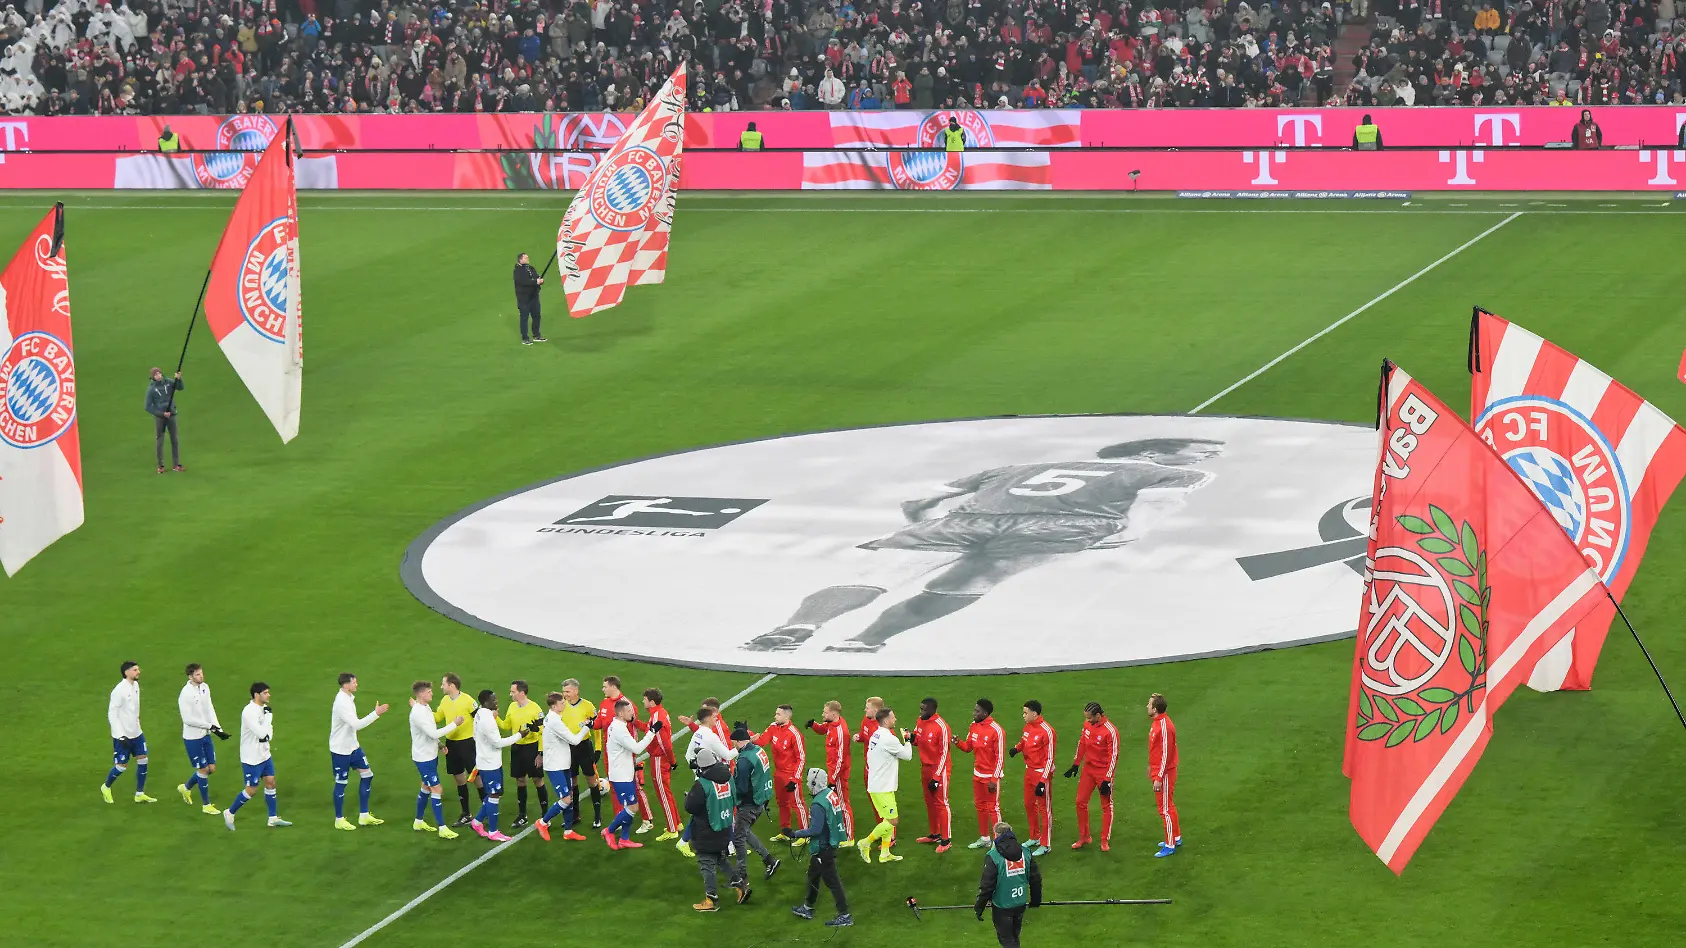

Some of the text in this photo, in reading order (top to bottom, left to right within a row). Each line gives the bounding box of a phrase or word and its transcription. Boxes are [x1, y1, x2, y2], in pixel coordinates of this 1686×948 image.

[221, 116, 273, 145] FC BAYER
[923, 123, 937, 143] FC
[628, 152, 663, 221] FC BAYERN
[244, 250, 284, 333] MÜNCH
[21, 338, 75, 425] FC BAYERN
[1008, 469, 1114, 497] 5
[536, 527, 705, 537] BUNDESLIGA
[720, 809, 730, 819] 04
[1011, 886, 1023, 898] 20
